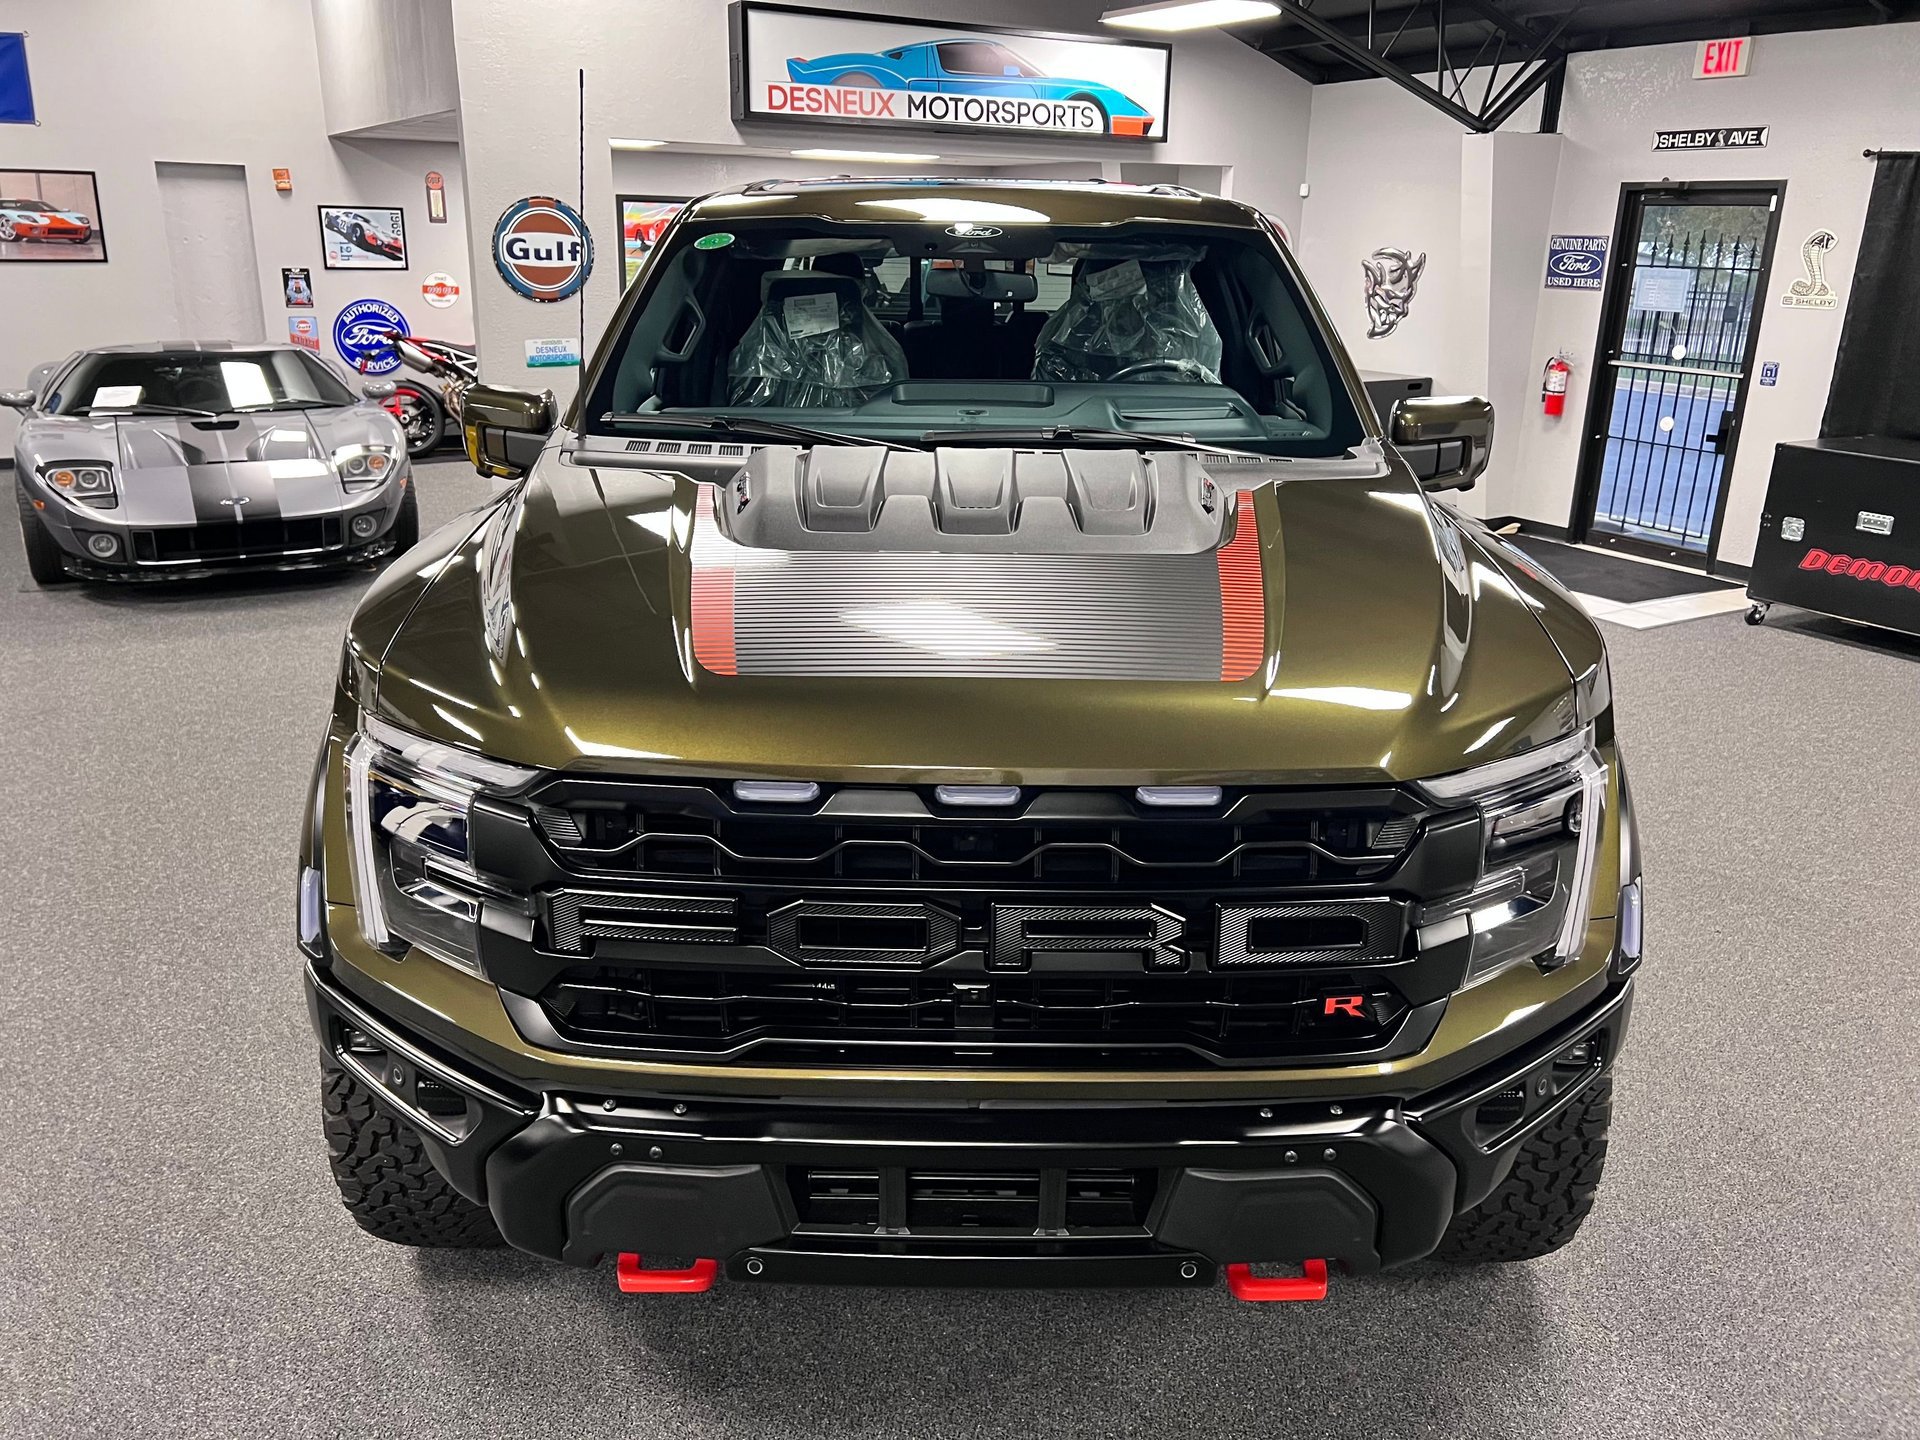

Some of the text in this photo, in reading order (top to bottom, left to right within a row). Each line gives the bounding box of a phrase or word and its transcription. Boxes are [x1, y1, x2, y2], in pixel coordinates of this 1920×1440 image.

[1703, 40, 1743, 74] EXIT
[767, 84, 1094, 128] DESNEUX MOTORSPORTS
[1658, 130, 1760, 148] SHELBY AVE.
[390, 212, 402, 237] 1969
[505, 237, 582, 261] Gulf
[1550, 238, 1608, 251] GENUINE PARTS
[1559, 254, 1592, 272] Ford
[1547, 276, 1601, 288] USED HERE
[1795, 298, 1833, 306] SHELBY
[342, 303, 399, 325] AUTHORIZED
[535, 345, 568, 354] DESNEUX
[353, 356, 396, 370] SRVICE
[547, 888, 1408, 971] FORD
[1324, 995, 1365, 1018] R
